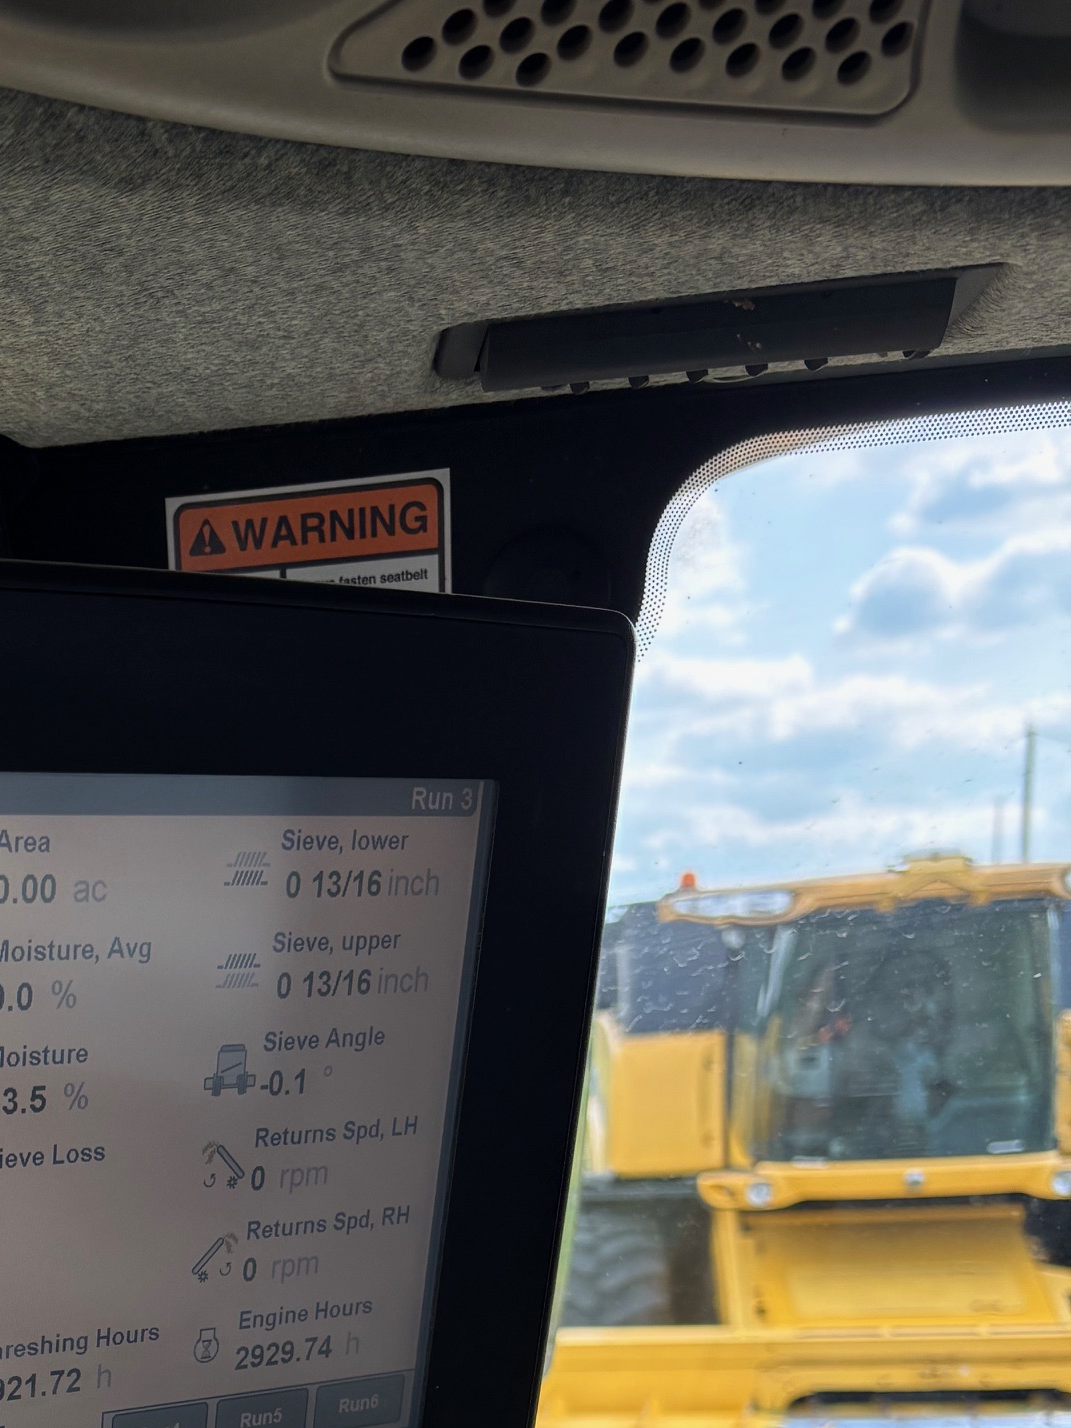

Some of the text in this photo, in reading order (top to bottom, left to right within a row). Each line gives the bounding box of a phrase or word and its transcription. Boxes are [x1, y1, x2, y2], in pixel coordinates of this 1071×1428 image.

[231, 501, 428, 551] WARNING
[379, 568, 428, 584] seatbelt
[411, 786, 474, 811] Run 3
[280, 828, 409, 855] Sieve, lower
[73, 879, 108, 903] ac
[285, 867, 440, 899] 0 13/16 inch
[107, 936, 152, 964] Avg
[272, 931, 402, 957] Sieve, upper
[51, 979, 78, 1010] %
[276, 965, 429, 999] 0 13/16 inch
[263, 1025, 385, 1052] Sieve Angle
[63, 1081, 89, 1112] %
[260, 1068, 306, 1097] -0.1
[254, 1115, 418, 1148] Returns Spd, LH
[52, 1144, 106, 1166] Loss
[251, 1165, 328, 1194] 0 rpm
[247, 1205, 410, 1241] Returns Spd, RH
[242, 1255, 319, 1285] 0 rpm
[239, 1299, 373, 1332] Engine Hours
[96, 1326, 160, 1348] Hours
[234, 1331, 359, 1371] 2929.74 h
[96, 1363, 111, 1390] h
[240, 1408, 282, 1428] Run5
[338, 1394, 379, 1414] Run6
